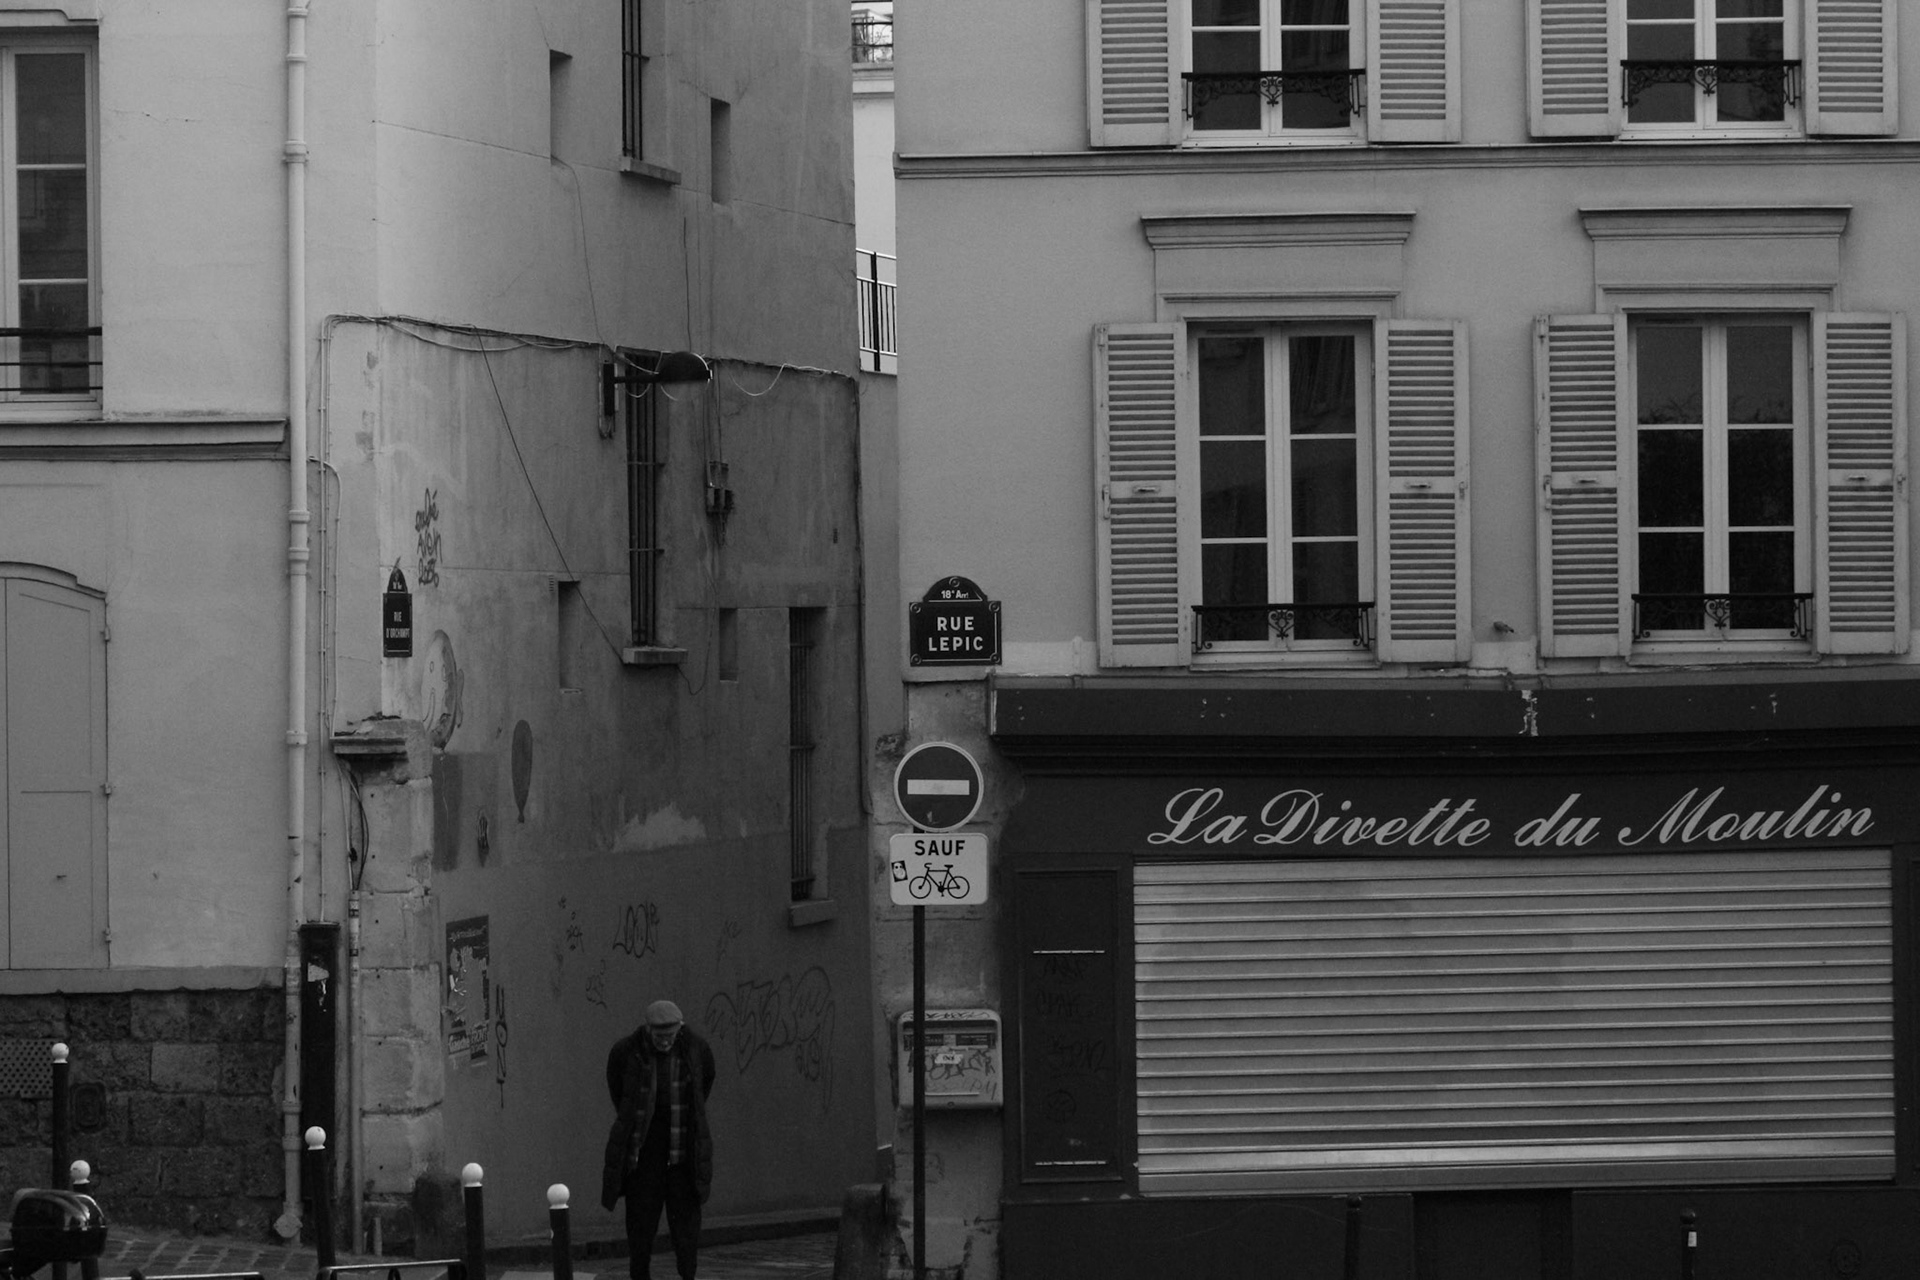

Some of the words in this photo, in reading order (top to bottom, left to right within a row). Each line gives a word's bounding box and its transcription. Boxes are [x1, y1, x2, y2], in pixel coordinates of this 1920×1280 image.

[393, 611, 402, 622] RUE
[937, 616, 975, 631] RUE
[928, 636, 984, 652] LEPIC
[1147, 787, 1248, 845] La
[1253, 788, 1491, 847] Divette
[1514, 792, 1601, 847] du
[1618, 784, 1875, 846] Moulin
[914, 839, 966, 856] SAUF
